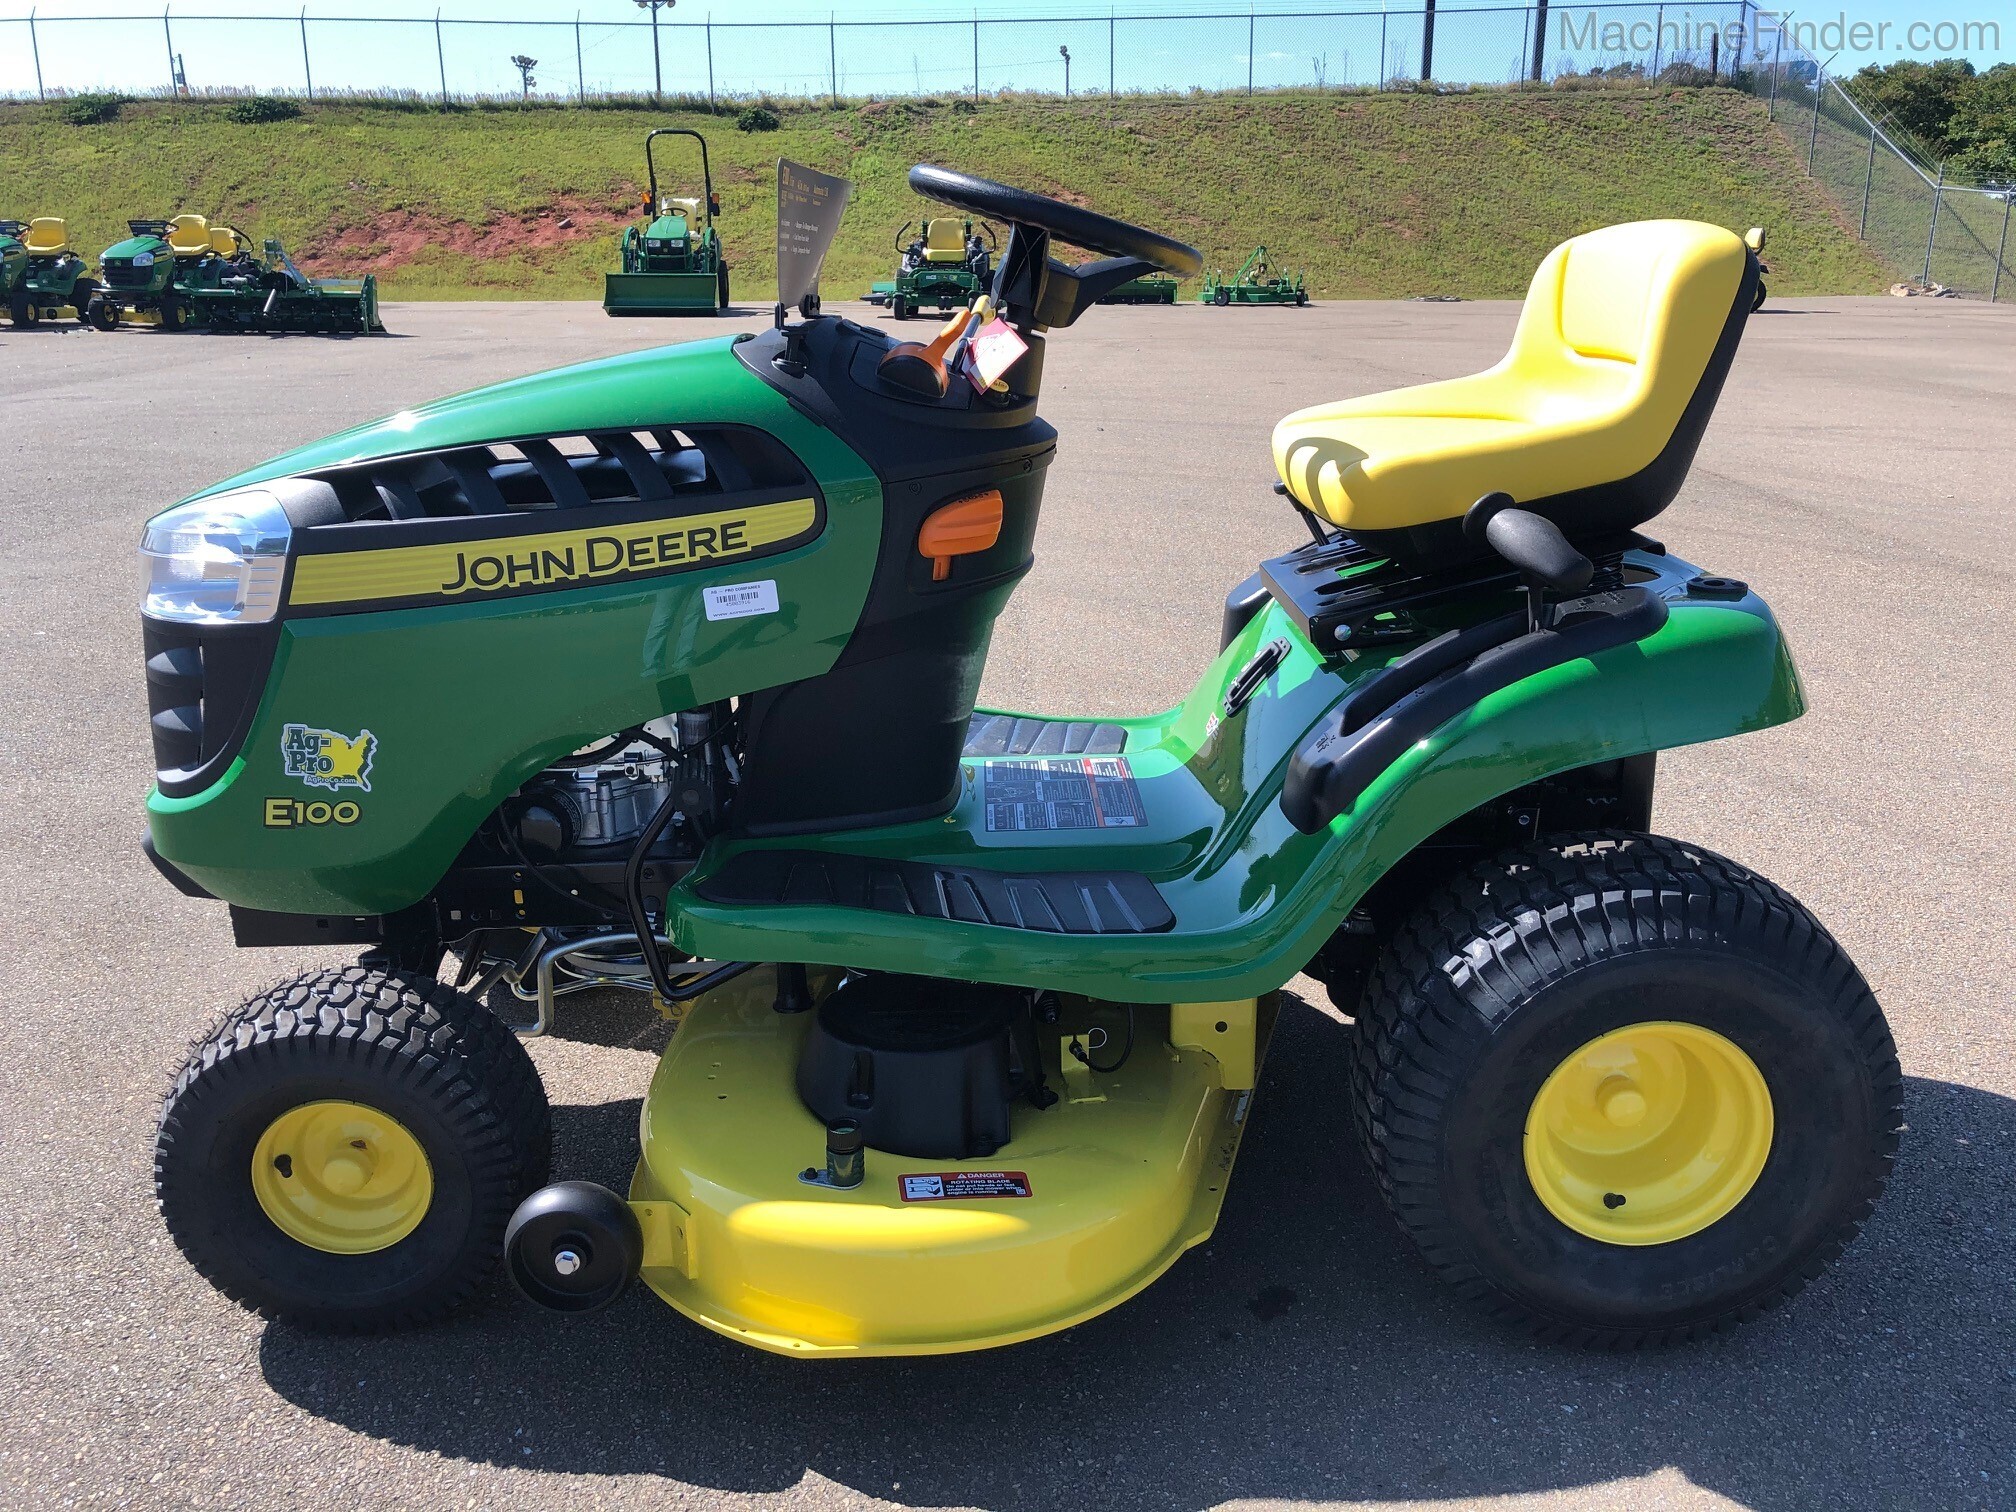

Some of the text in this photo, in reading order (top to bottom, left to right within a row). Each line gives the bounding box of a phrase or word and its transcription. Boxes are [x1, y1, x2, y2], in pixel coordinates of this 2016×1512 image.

[442, 520, 748, 591] JOHN DEERE
[286, 727, 331, 756] Ag-
[288, 750, 334, 774] Pro
[264, 798, 360, 826] E100
